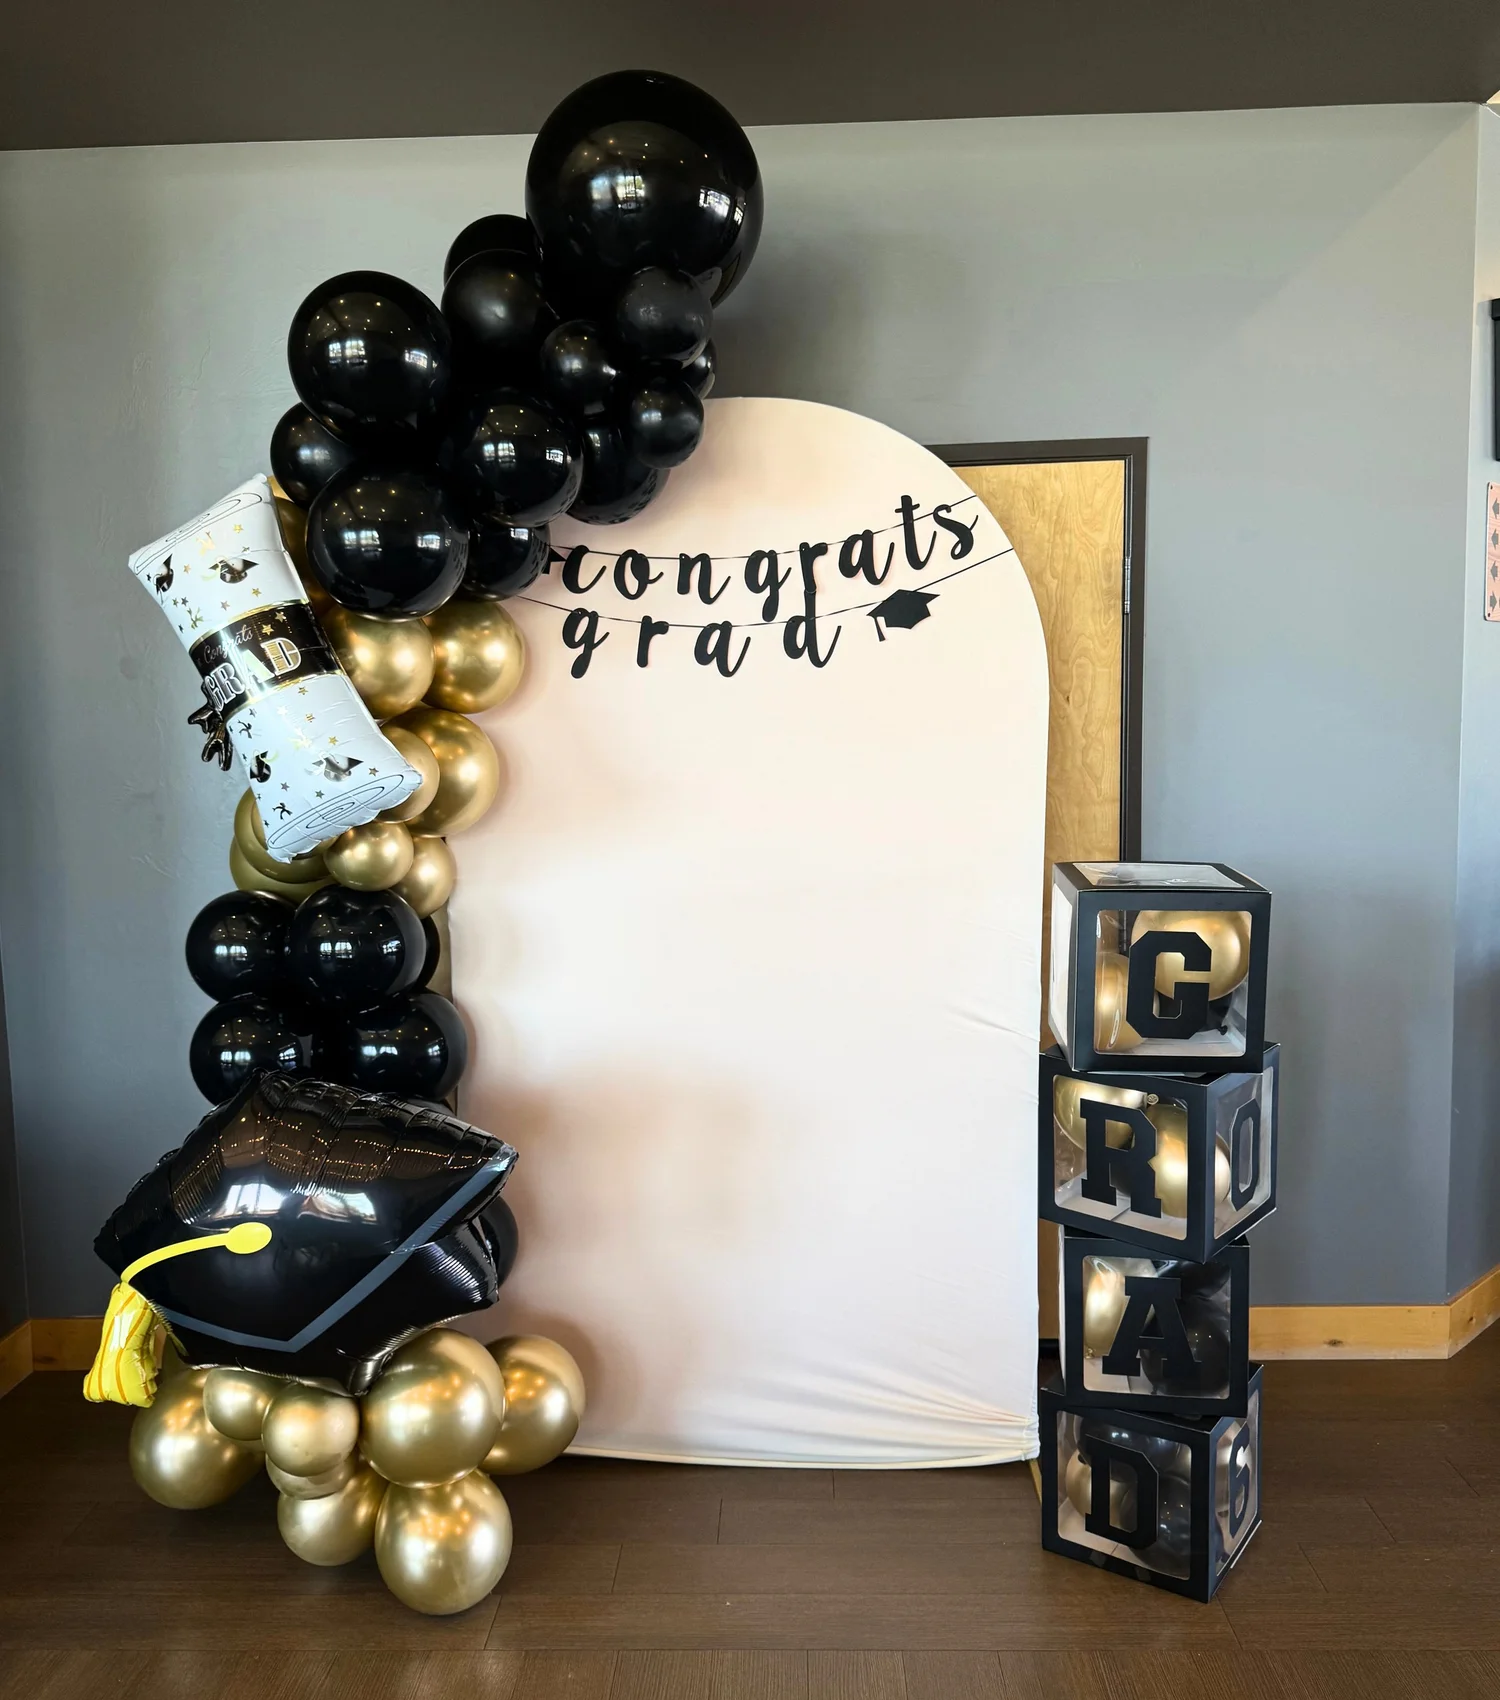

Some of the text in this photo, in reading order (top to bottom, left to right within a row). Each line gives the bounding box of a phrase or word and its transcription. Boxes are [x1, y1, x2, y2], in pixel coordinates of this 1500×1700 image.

[562, 495, 978, 622] congrats
[203, 624, 253, 663] Congrats
[204, 637, 302, 711] GRAD
[562, 591, 841, 678] grad
[1126, 931, 1212, 1039] G
[1080, 1098, 1161, 1218] R
[1102, 1276, 1203, 1378] A
[1085, 1434, 1159, 1548] D
[1229, 1420, 1252, 1539] 6
